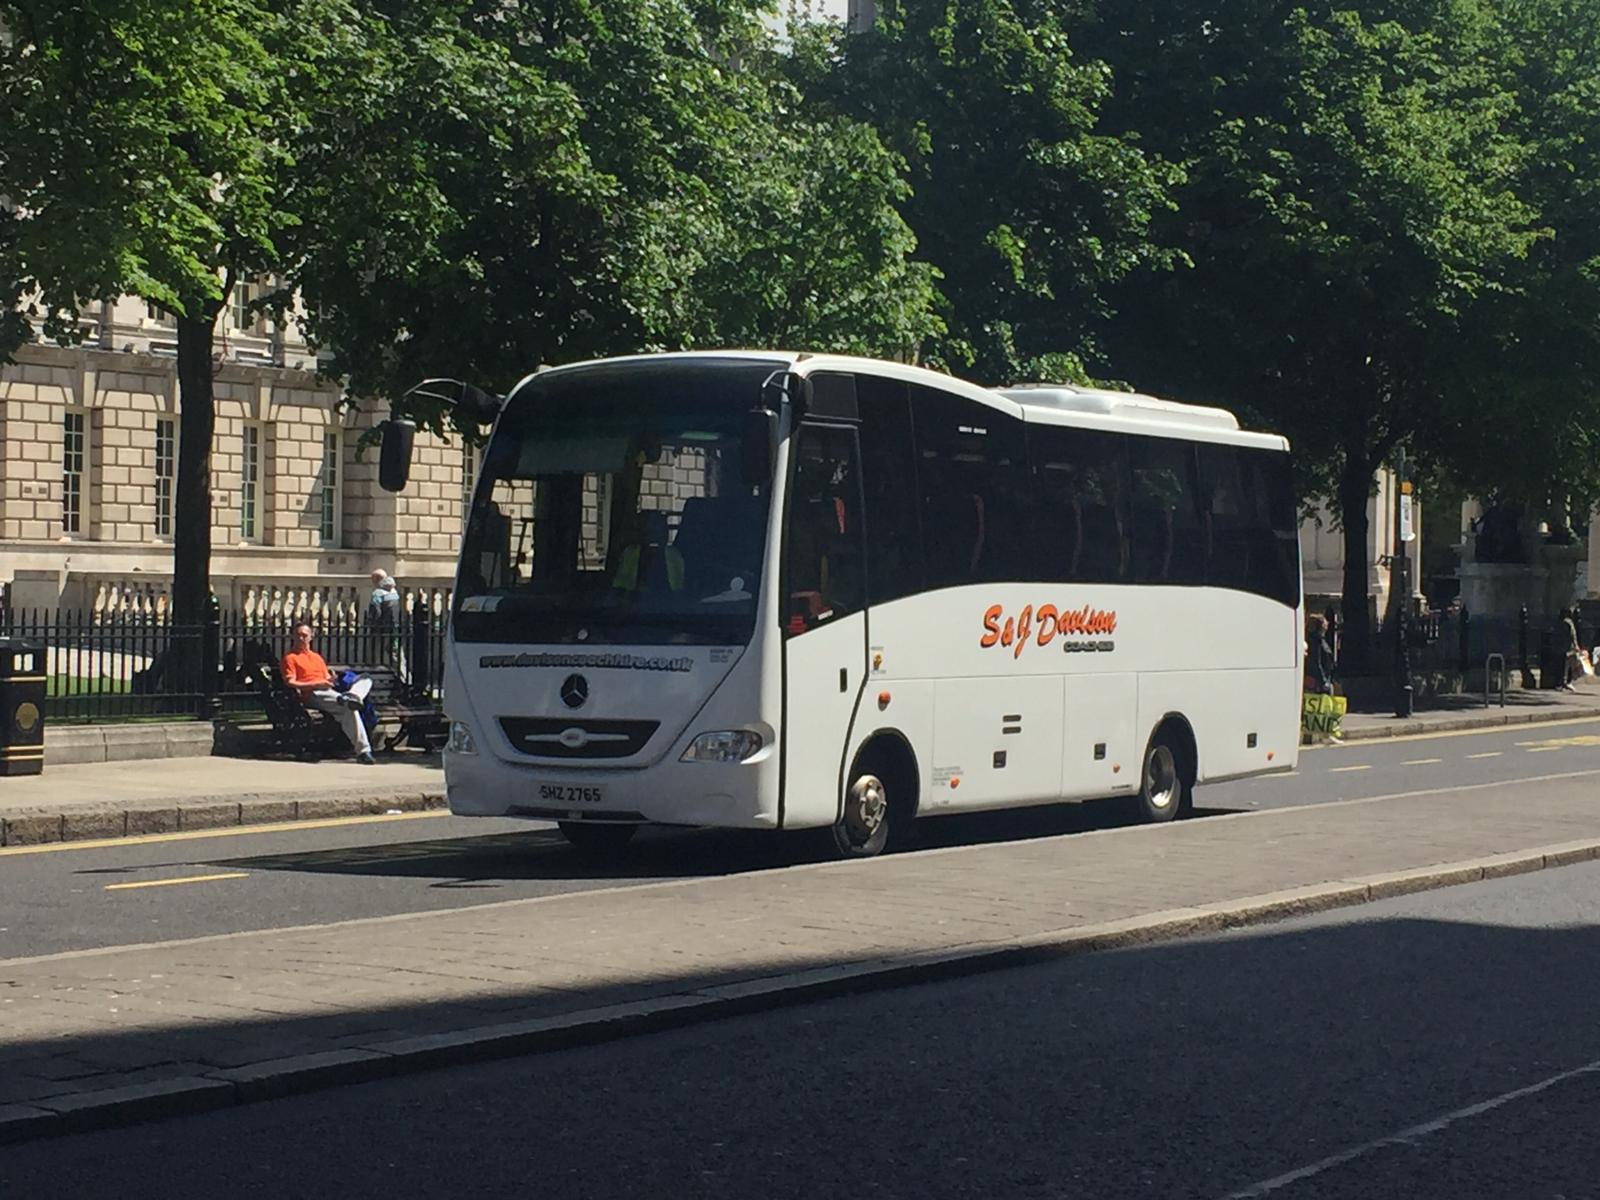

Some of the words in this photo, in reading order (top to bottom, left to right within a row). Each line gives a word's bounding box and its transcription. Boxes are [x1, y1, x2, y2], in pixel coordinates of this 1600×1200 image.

[981, 604, 1002, 648] S
[1001, 616, 1014, 647] &
[1014, 604, 1033, 659] J
[1037, 604, 1117, 646] Davison
[480, 653, 694, 672] www.davisoncoachhire.co.uk
[540, 785, 564, 801] SHZ
[567, 787, 602, 802] 2765
